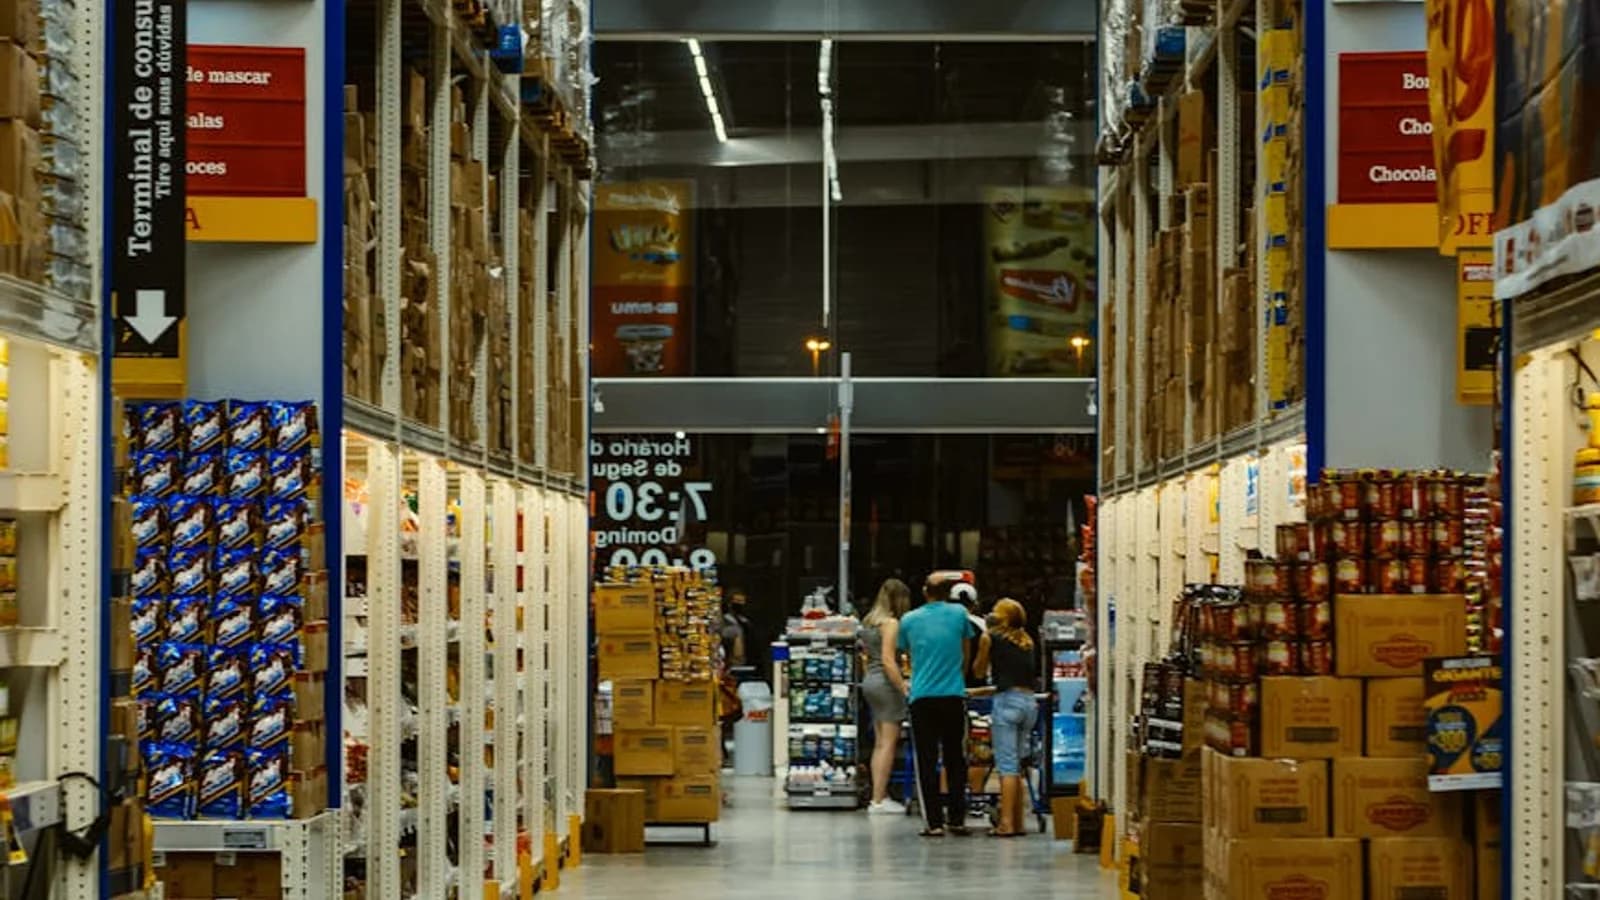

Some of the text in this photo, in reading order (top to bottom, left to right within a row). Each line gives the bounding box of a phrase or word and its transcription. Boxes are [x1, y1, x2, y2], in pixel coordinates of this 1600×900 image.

[155, 5, 171, 73] dúvidas
[208, 71, 271, 84] mascar
[159, 77, 171, 115] suas
[127, 0, 153, 257] Terminal de consu
[186, 112, 224, 128] alas
[1399, 118, 1434, 135] Cho
[155, 120, 176, 158] aqui
[1369, 166, 1437, 183] Chocola
